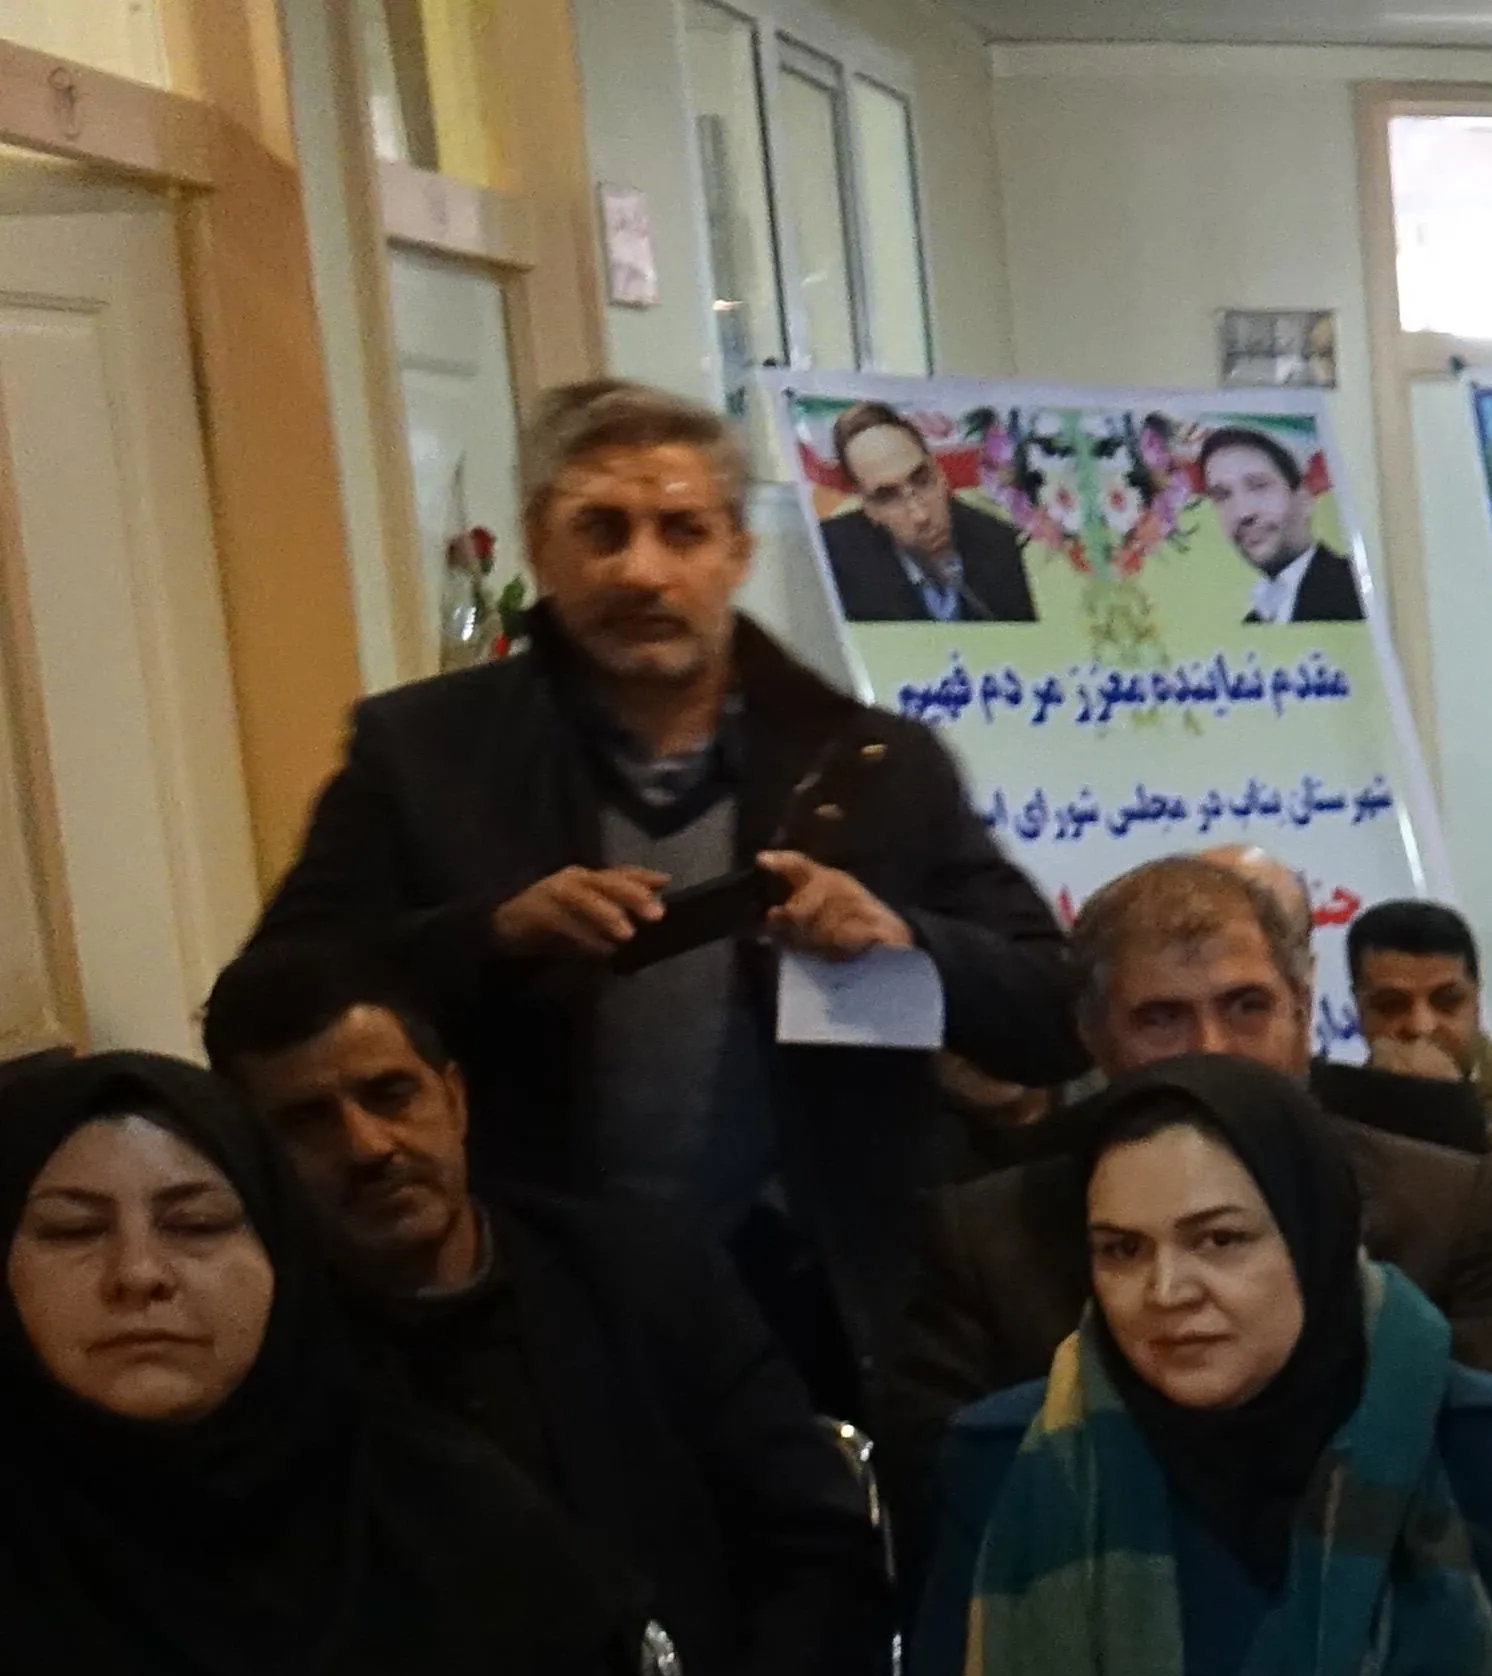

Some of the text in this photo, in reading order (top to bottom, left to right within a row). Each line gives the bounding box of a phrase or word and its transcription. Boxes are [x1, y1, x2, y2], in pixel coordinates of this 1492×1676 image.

[980, 667, 1064, 725] مردم
[1150, 652, 1264, 716] نماینده
[1270, 650, 1348, 717] مقدم
[1107, 783, 1188, 836] مجلس
[1199, 789, 1222, 833] در
[1288, 774, 1393, 827] شهرستان
